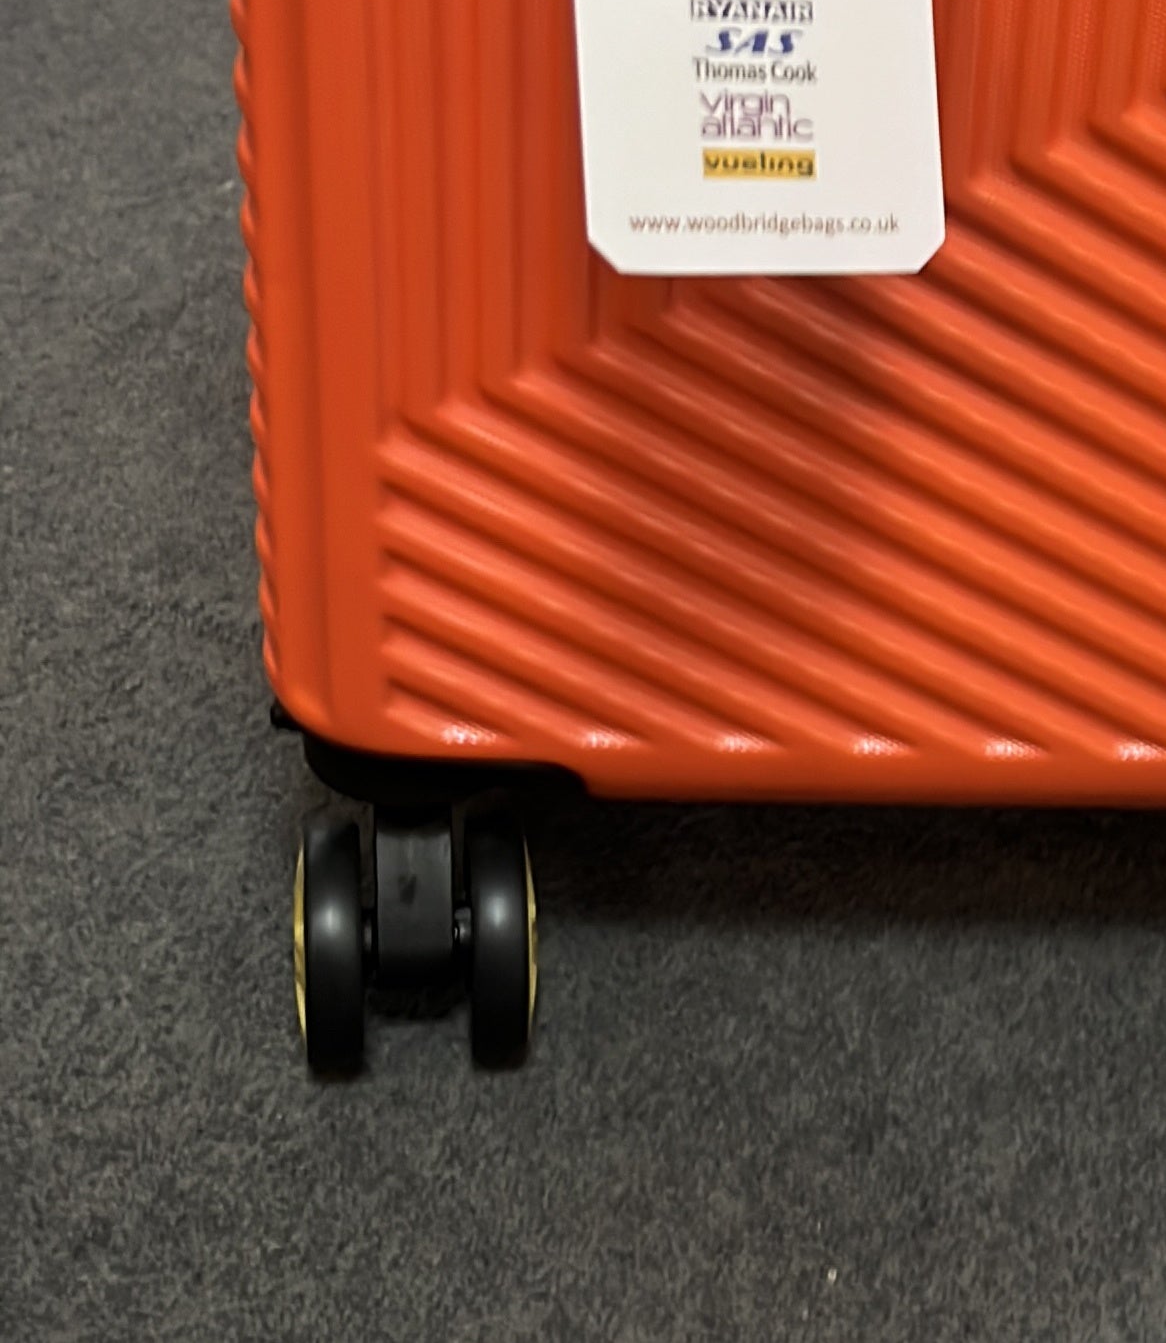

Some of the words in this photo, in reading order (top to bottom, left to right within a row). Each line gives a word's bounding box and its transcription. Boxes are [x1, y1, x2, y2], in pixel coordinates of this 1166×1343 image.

[705, 26, 803, 54] SAS
[693, 57, 767, 83] Thomas
[771, 60, 817, 85] Cook
[700, 88, 791, 118] virgin
[703, 151, 815, 178] vueling
[629, 210, 899, 238] www.woodbridgebags.co.uk
